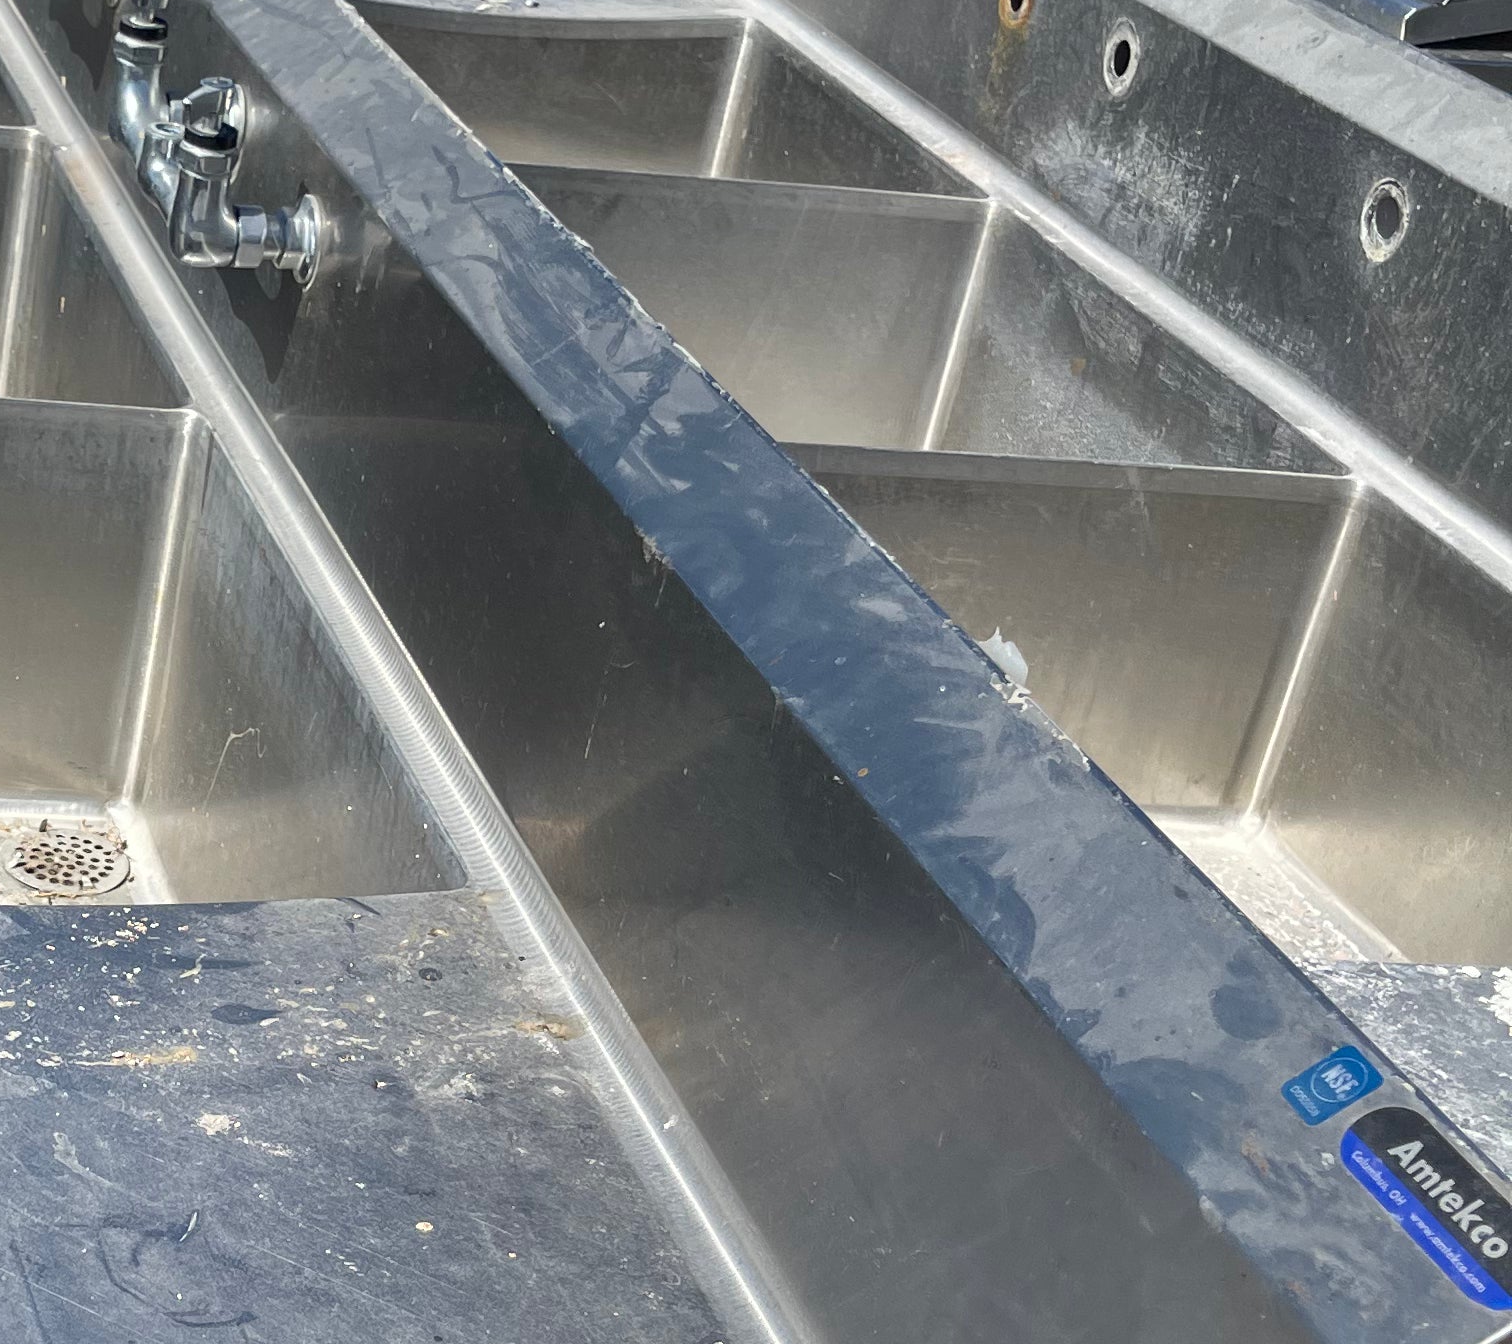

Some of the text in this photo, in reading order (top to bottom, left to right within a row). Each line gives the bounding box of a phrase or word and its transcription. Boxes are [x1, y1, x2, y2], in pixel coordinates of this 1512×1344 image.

[1321, 1064, 1359, 1094] NSF
[1387, 1140, 1509, 1259] Amtekco
[1388, 1189, 1407, 1206] OH
